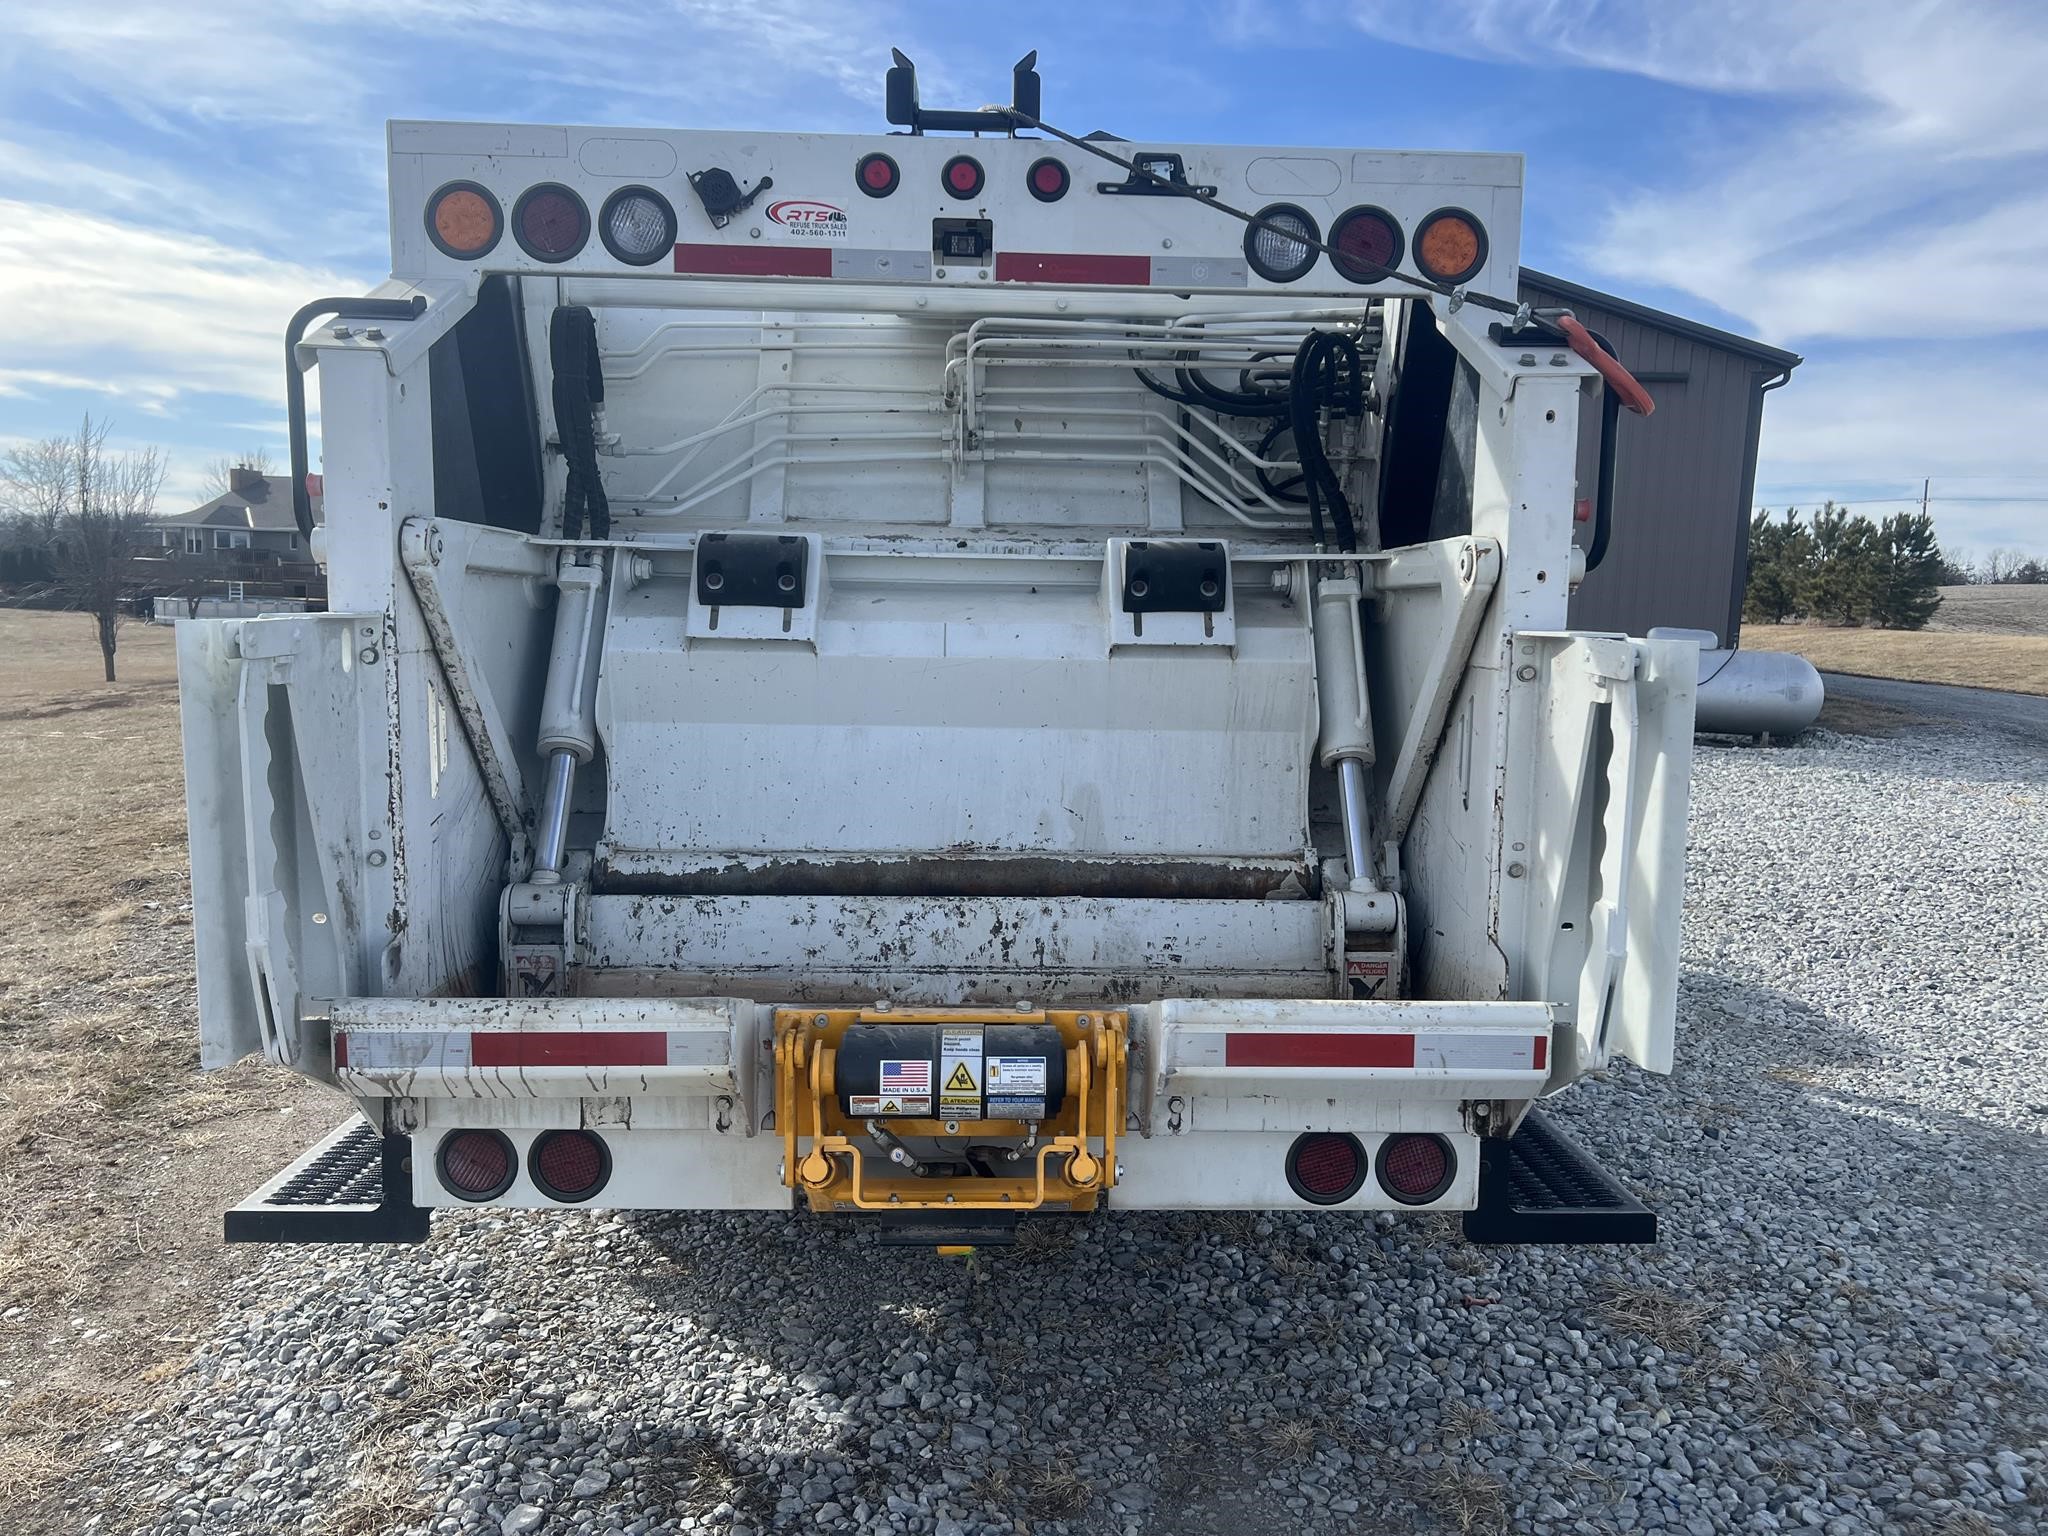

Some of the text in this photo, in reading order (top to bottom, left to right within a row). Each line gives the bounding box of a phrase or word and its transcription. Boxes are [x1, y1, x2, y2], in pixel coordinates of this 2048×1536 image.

[786, 210, 829, 222] RTS
[811, 222, 830, 230] TRUCK
[790, 228, 846, 237] 402-560-1311
